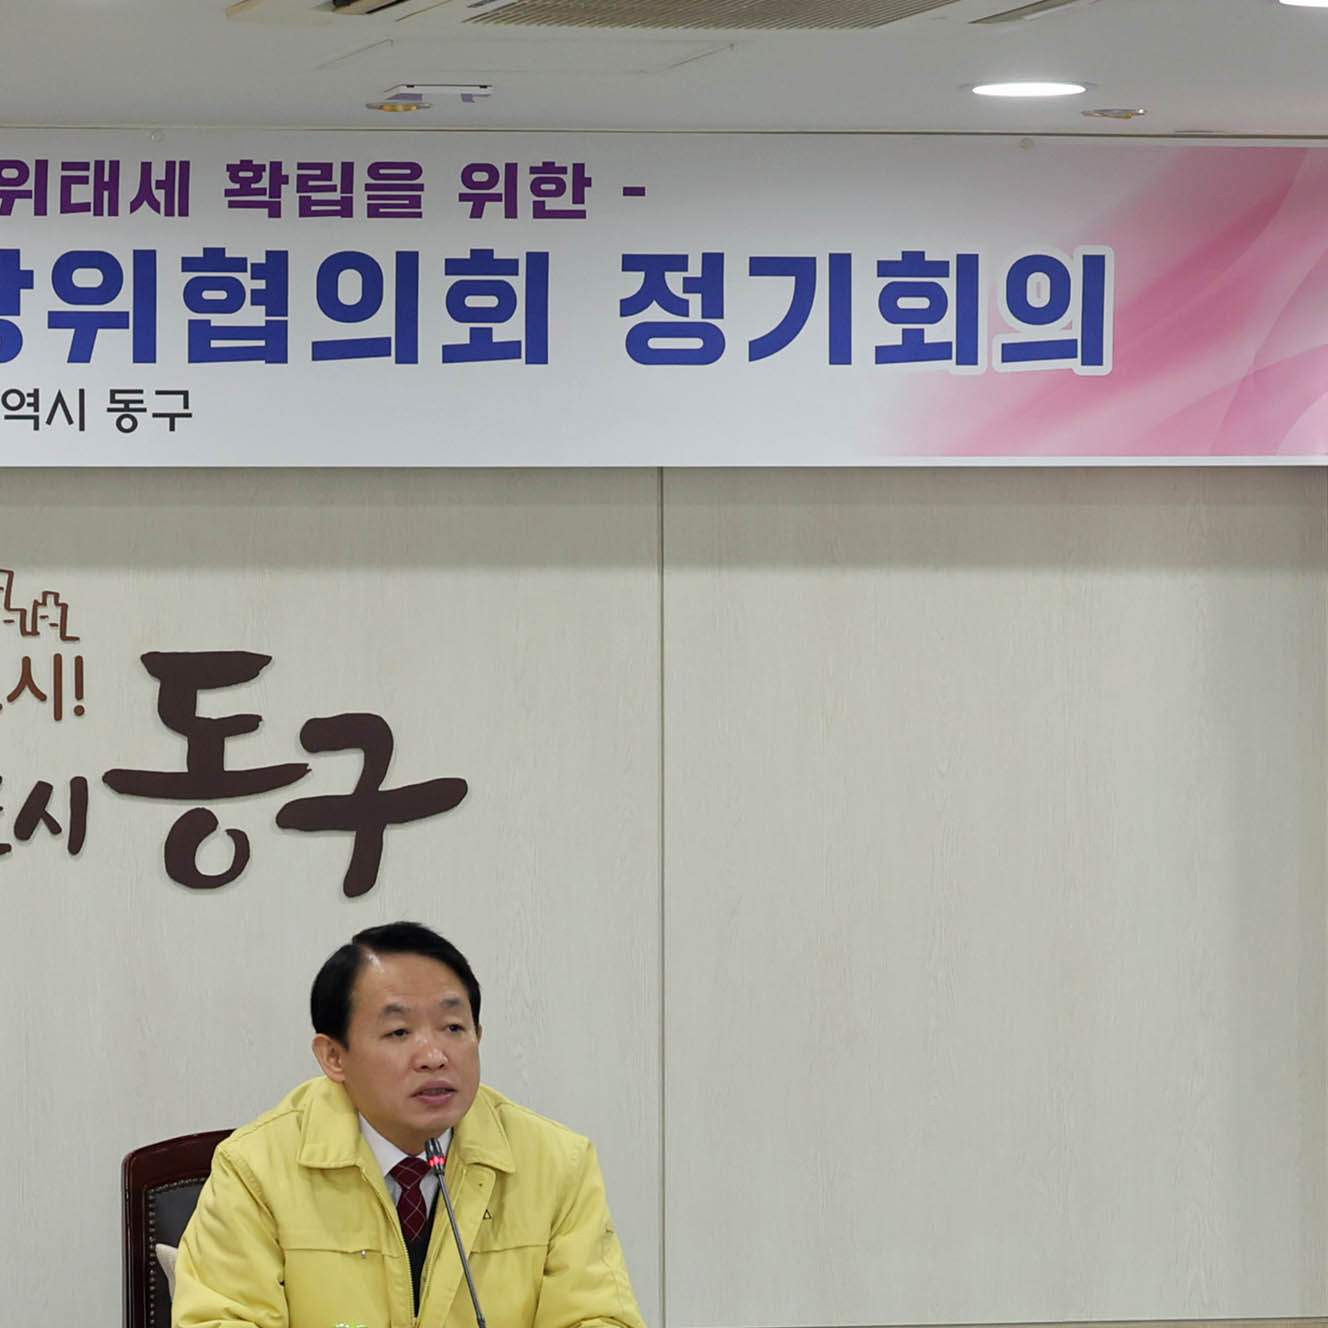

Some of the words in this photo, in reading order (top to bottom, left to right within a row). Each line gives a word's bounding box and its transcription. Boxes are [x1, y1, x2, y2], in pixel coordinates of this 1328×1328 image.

[224, 159, 426, 220] 확립을
[459, 161, 594, 221] 위한
[620, 251, 1107, 368] 정기회의
[107, 390, 194, 435] 동구
[102, 650, 469, 897] 동구
